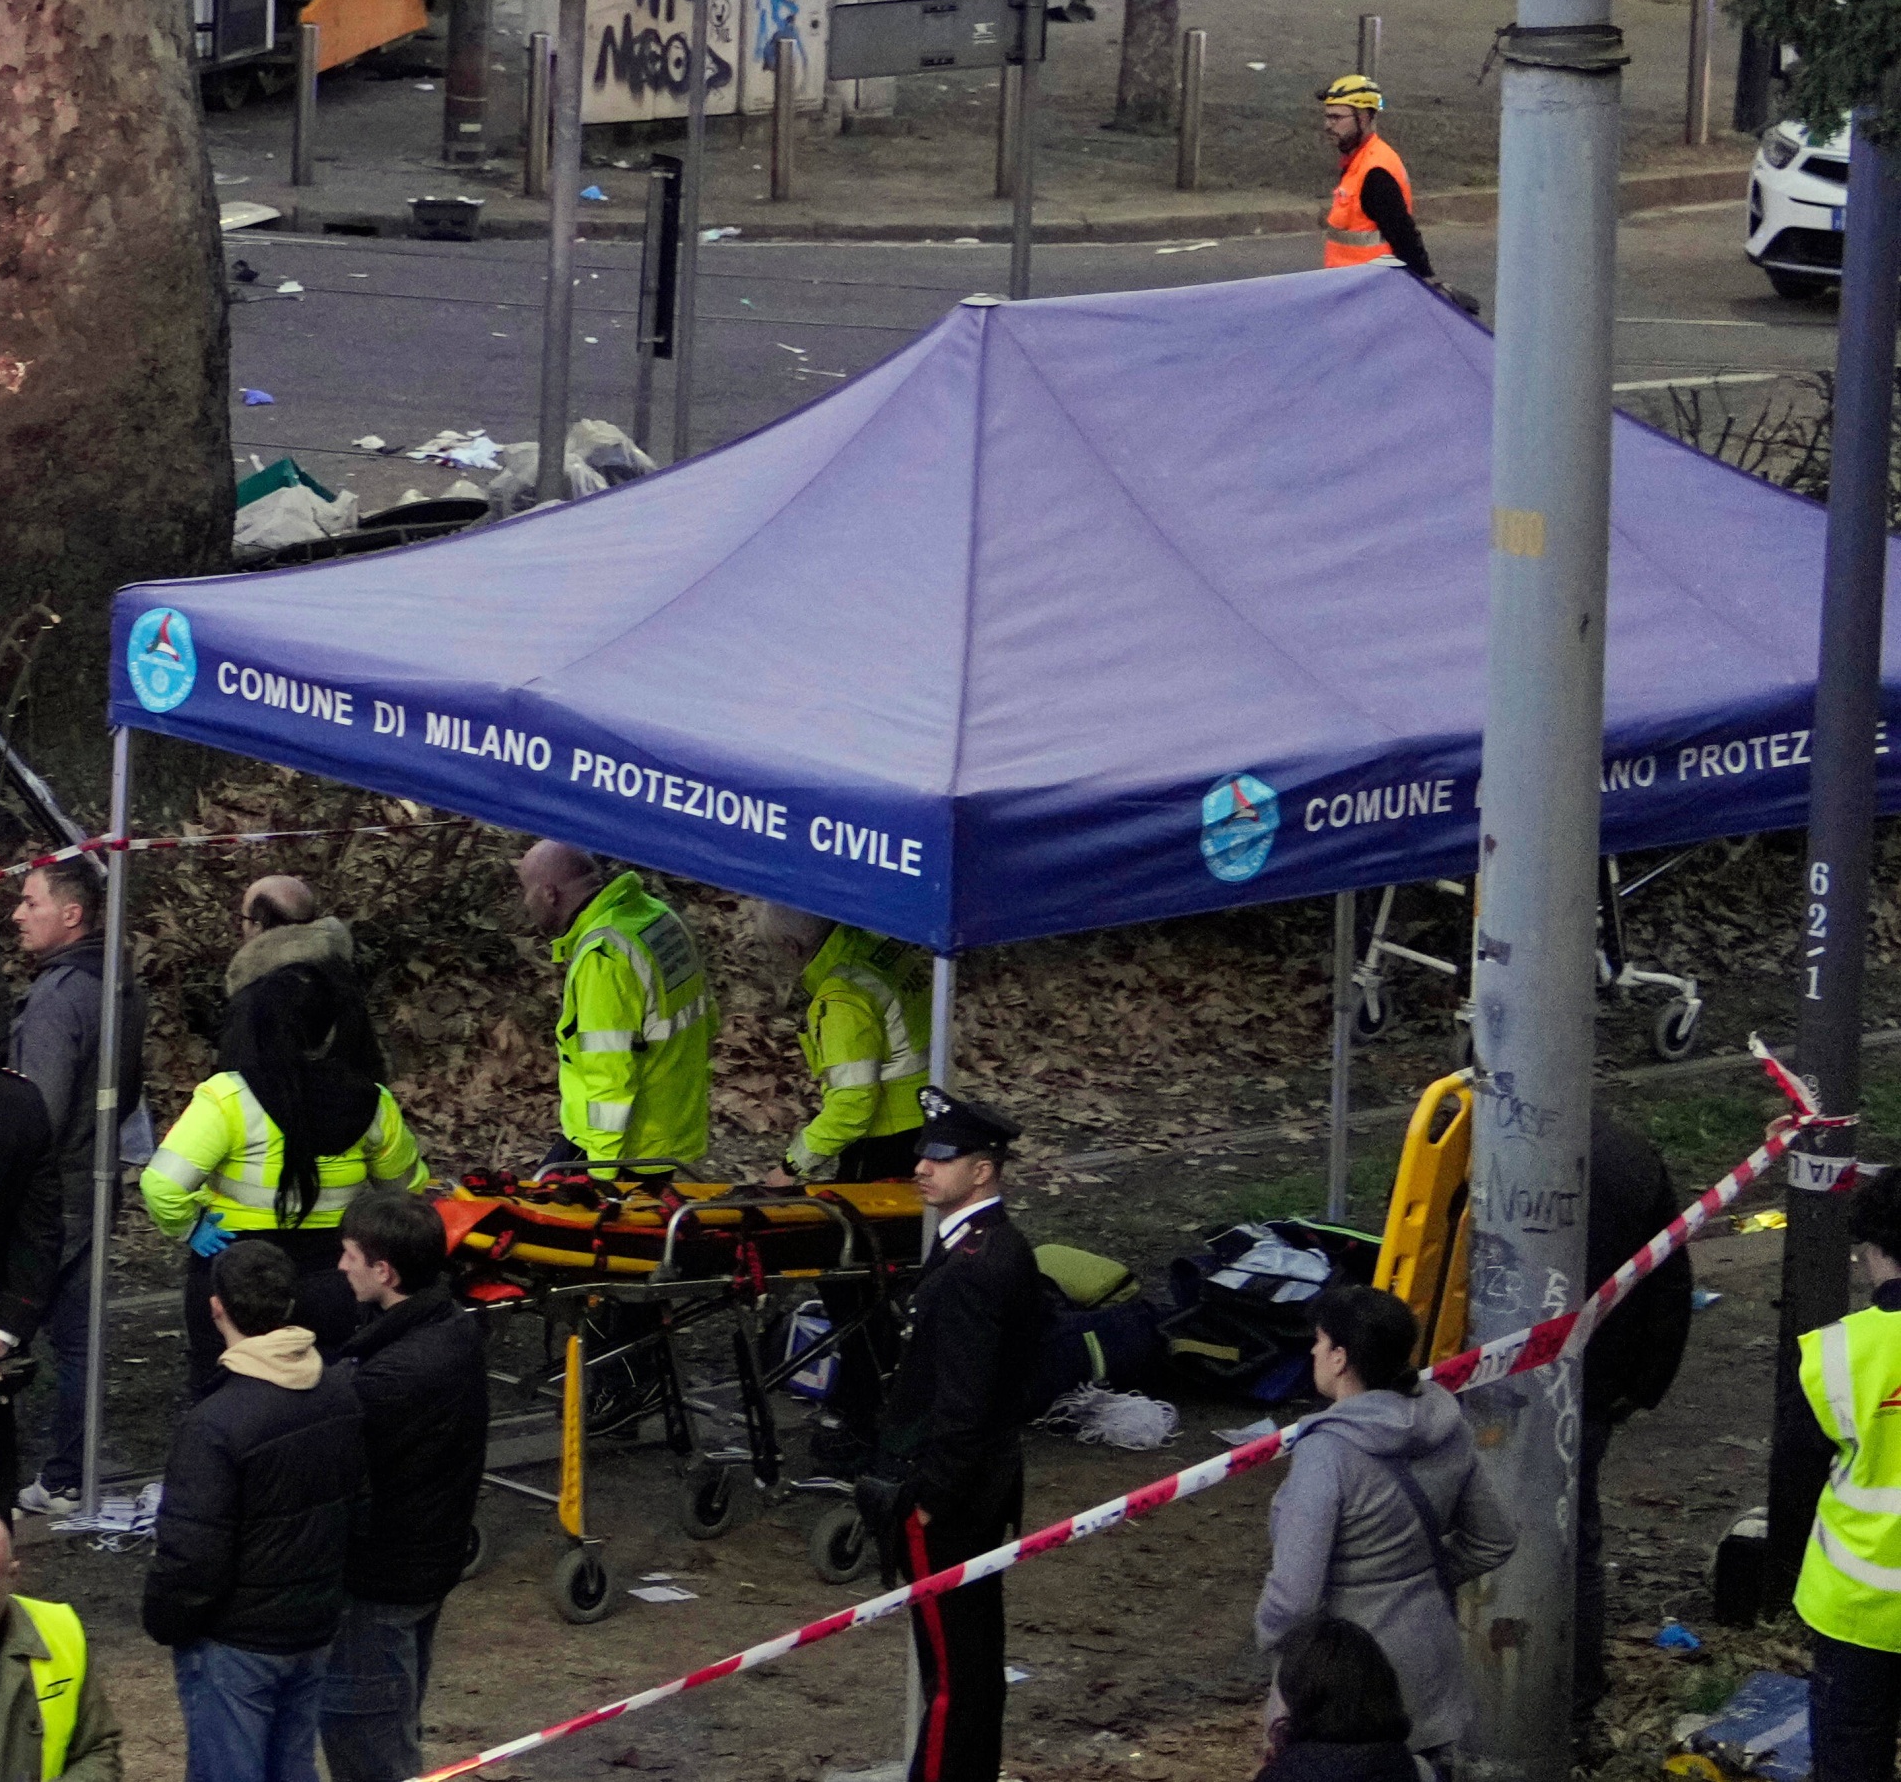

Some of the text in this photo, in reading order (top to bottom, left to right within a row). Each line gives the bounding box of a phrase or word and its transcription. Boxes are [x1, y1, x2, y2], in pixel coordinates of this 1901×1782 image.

[217, 661, 354, 726] COMUNE
[372, 700, 406, 738] DI
[425, 711, 552, 771] MILANO
[570, 748, 788, 840] PROTEZIONE
[809, 815, 923, 878] CIVILE
[1303, 779, 1454, 832] COMUNE
